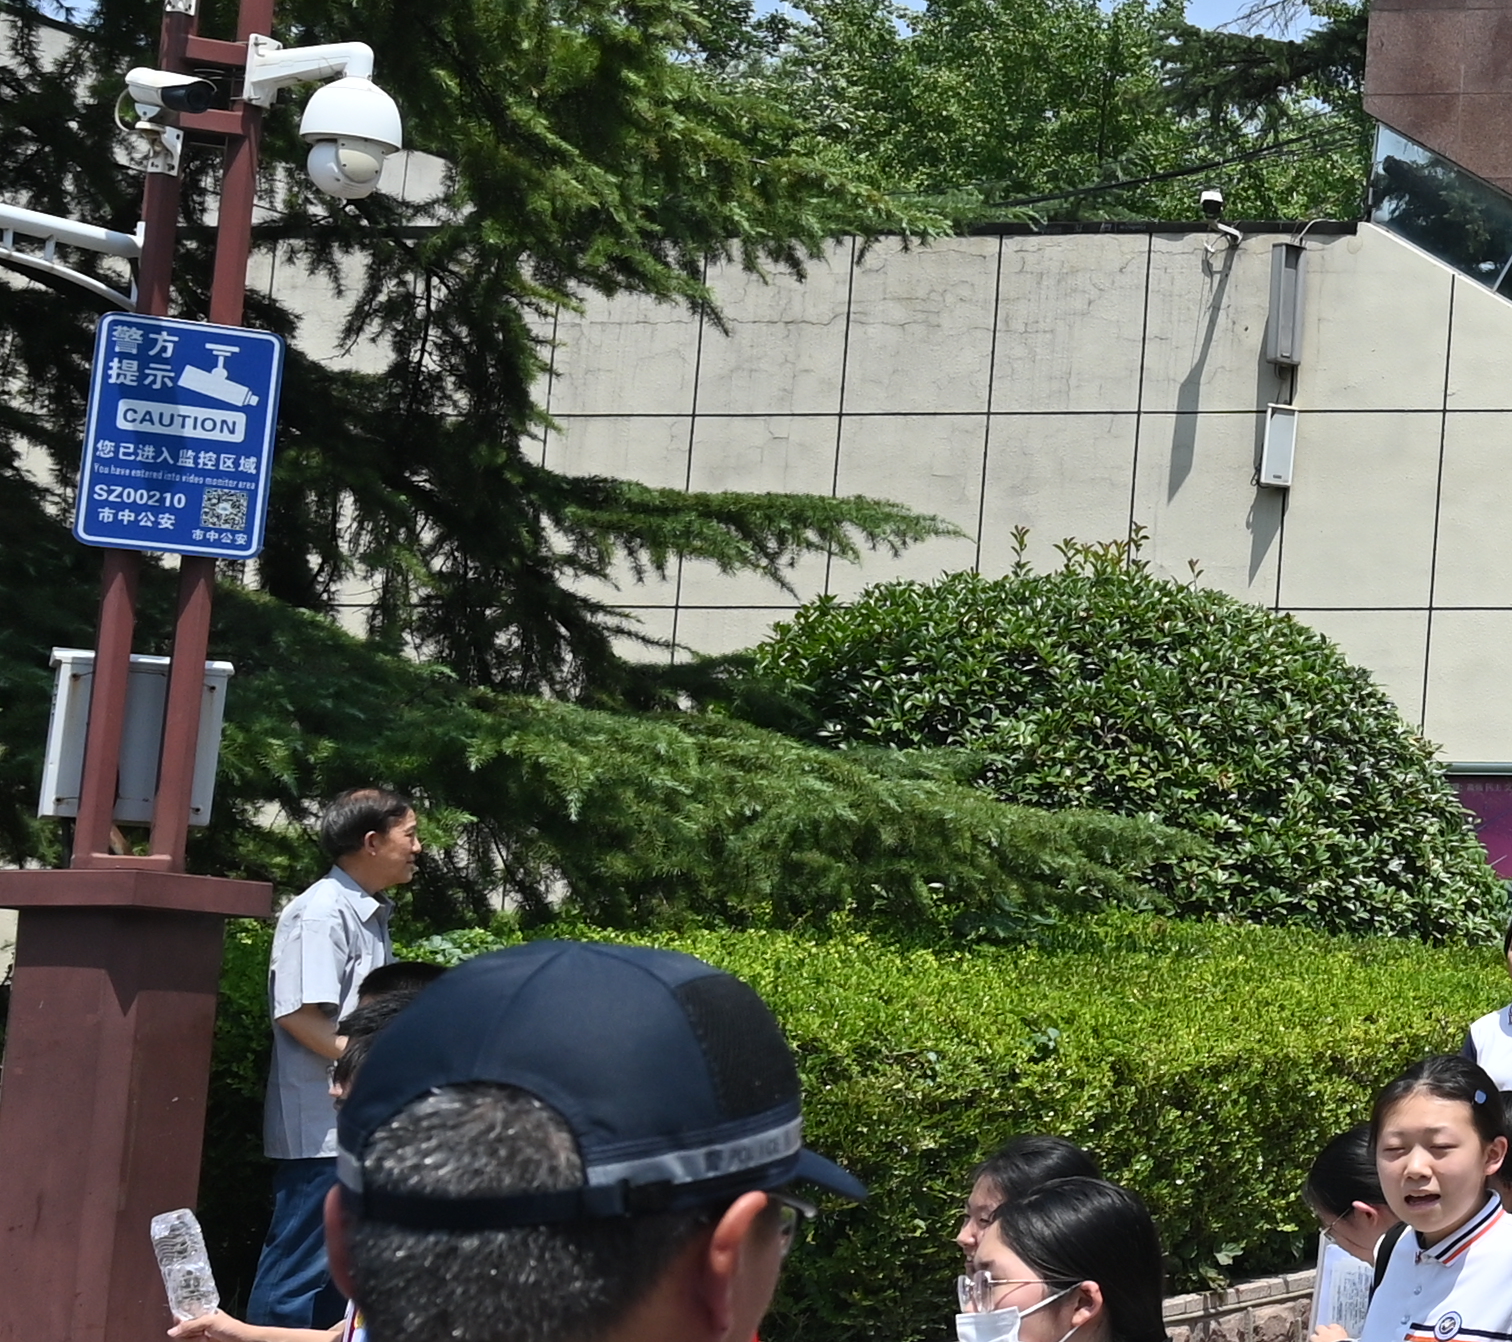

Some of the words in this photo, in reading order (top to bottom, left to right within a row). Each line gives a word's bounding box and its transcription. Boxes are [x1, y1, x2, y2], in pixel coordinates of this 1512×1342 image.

[112, 325, 179, 358] 警方
[108, 358, 175, 389] 提示
[122, 408, 236, 435] CAUTION
[96, 440, 258, 474] 您已进入监控区域
[93, 463, 109, 475] You
[110, 465, 129, 476] have
[131, 468, 163, 479] entered
[164, 471, 180, 482] into
[182, 473, 204, 484] video
[205, 476, 237, 488] monitor
[238, 480, 255, 489] area
[93, 484, 186, 508] SZ00210
[98, 507, 175, 529] 市中公安
[192, 529, 248, 545] 市中公安
